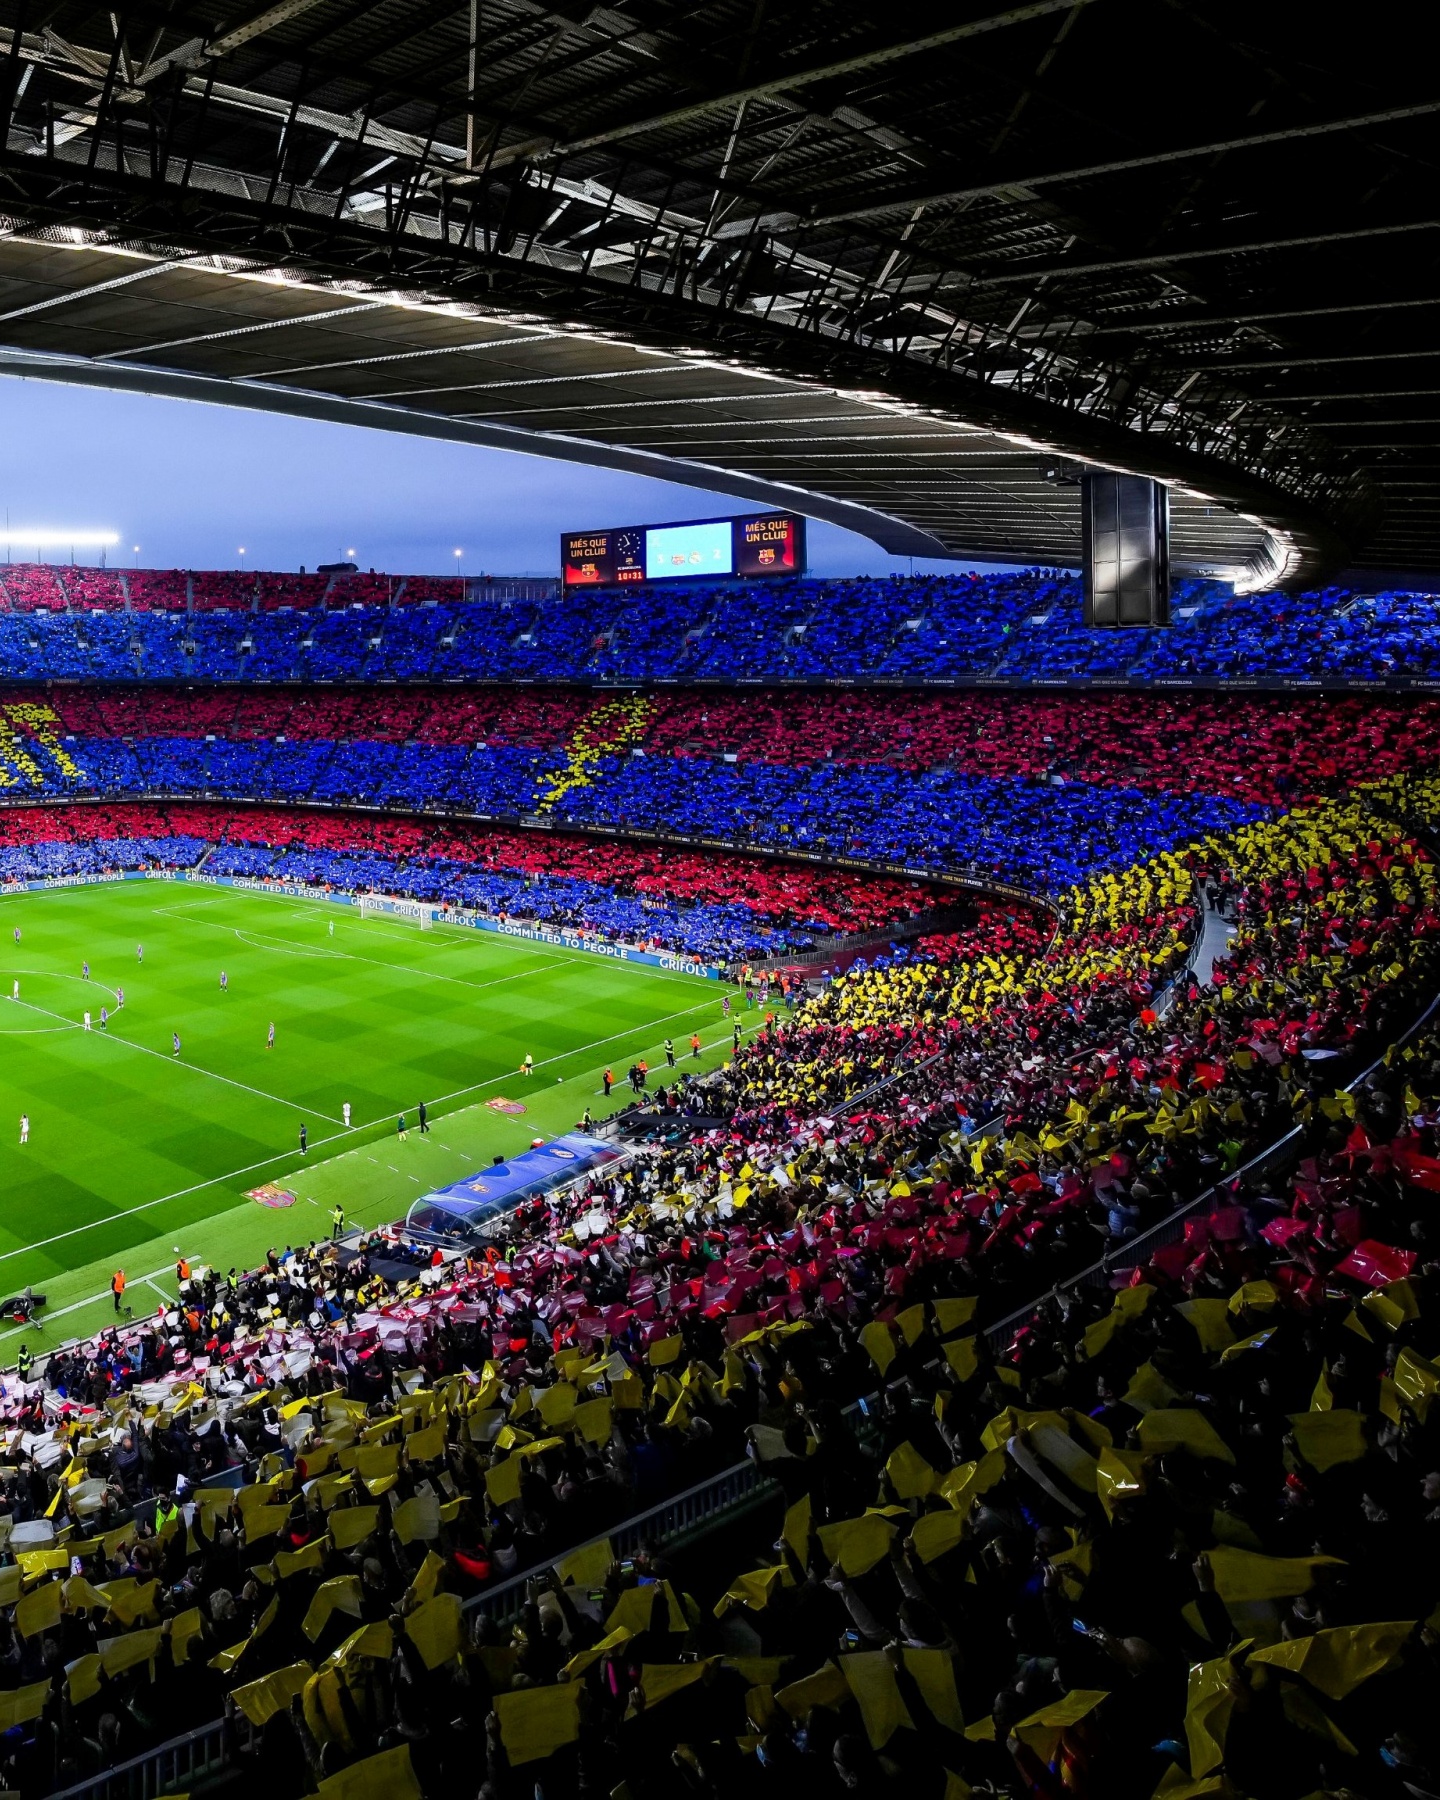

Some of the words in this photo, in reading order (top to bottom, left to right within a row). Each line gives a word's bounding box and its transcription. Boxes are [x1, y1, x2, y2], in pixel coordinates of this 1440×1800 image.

[745, 521, 766, 532] MÉS
[768, 520, 789, 530] QUE
[570, 538, 588, 548] MÉS
[589, 538, 607, 548] QUE
[746, 533, 760, 542] UN
[762, 531, 788, 541] CLUB
[571, 549, 583, 557] UN
[584, 547, 606, 557] CLUB
[617, 571, 643, 581] 10:31
[44, 877, 86, 888] COMMITTED
[98, 874, 125, 882] PEOPLE
[145, 870, 176, 880] GRIFOLS
[185, 872, 217, 884] GRIFOLS
[1, 883, 29, 893] GRIFOLS
[232, 879, 282, 893] COMMITTED
[283, 887, 295, 895] TO
[298, 889, 330, 901] PEOPLE
[351, 896, 384, 910] GRFOLS
[437, 912, 476, 927] GRIFOLS
[497, 924, 561, 944] COMMITTED
[564, 938, 580, 948] TO
[584, 941, 628, 959] PEOPLE
[659, 958, 707, 976] GRIFOLS
